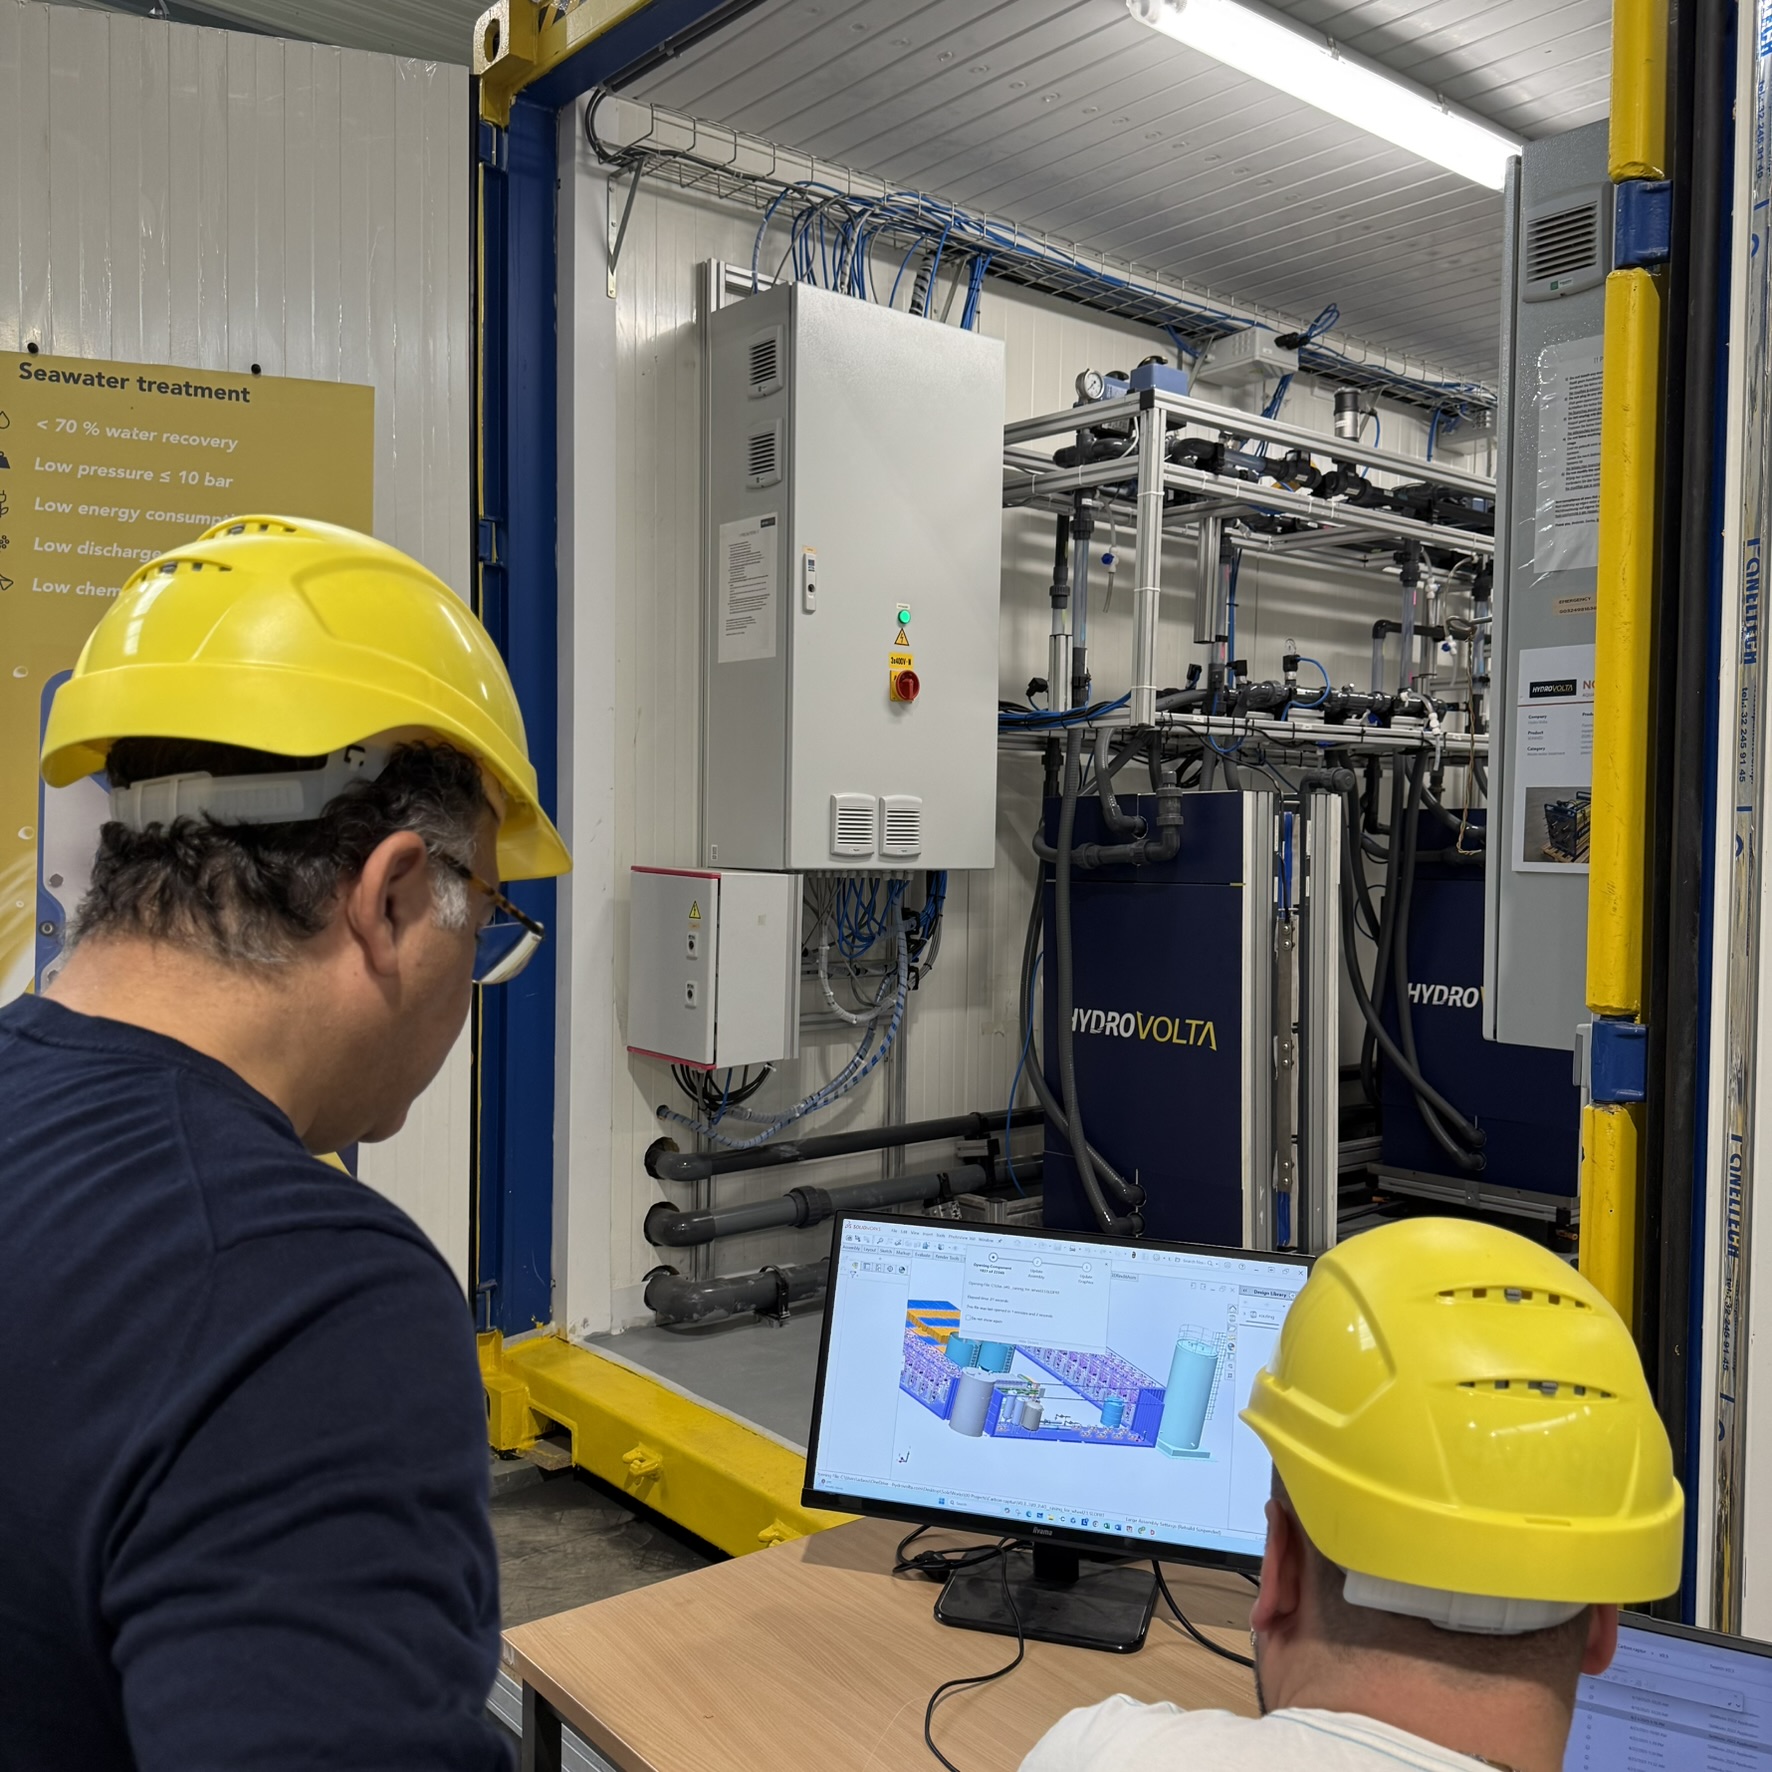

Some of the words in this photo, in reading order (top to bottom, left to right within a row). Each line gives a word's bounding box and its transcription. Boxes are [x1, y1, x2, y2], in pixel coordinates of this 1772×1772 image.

[19, 361, 129, 390] Seawater
[136, 375, 251, 403] treatment
[54, 418, 77, 434] 70
[82, 421, 100, 436] %
[105, 425, 158, 442] water
[162, 430, 239, 452] recovery
[34, 457, 73, 473] Low
[77, 463, 154, 481] pressure
[178, 470, 200, 485] 10
[204, 472, 234, 488] bar
[34, 497, 73, 513] Low
[78, 503, 141, 522] energy
[33, 537, 72, 553] Low
[32, 577, 71, 593] Low
[1532, 684, 1574, 694] HYDROVOLTA
[1741, 687, 1749, 708] tel.:
[1741, 712, 1748, 726] 32
[1740, 728, 1748, 749] 245
[1739, 752, 1747, 765] 91
[1738, 769, 1746, 783] 45
[1072, 998, 1217, 1051] HYDROVOLTA
